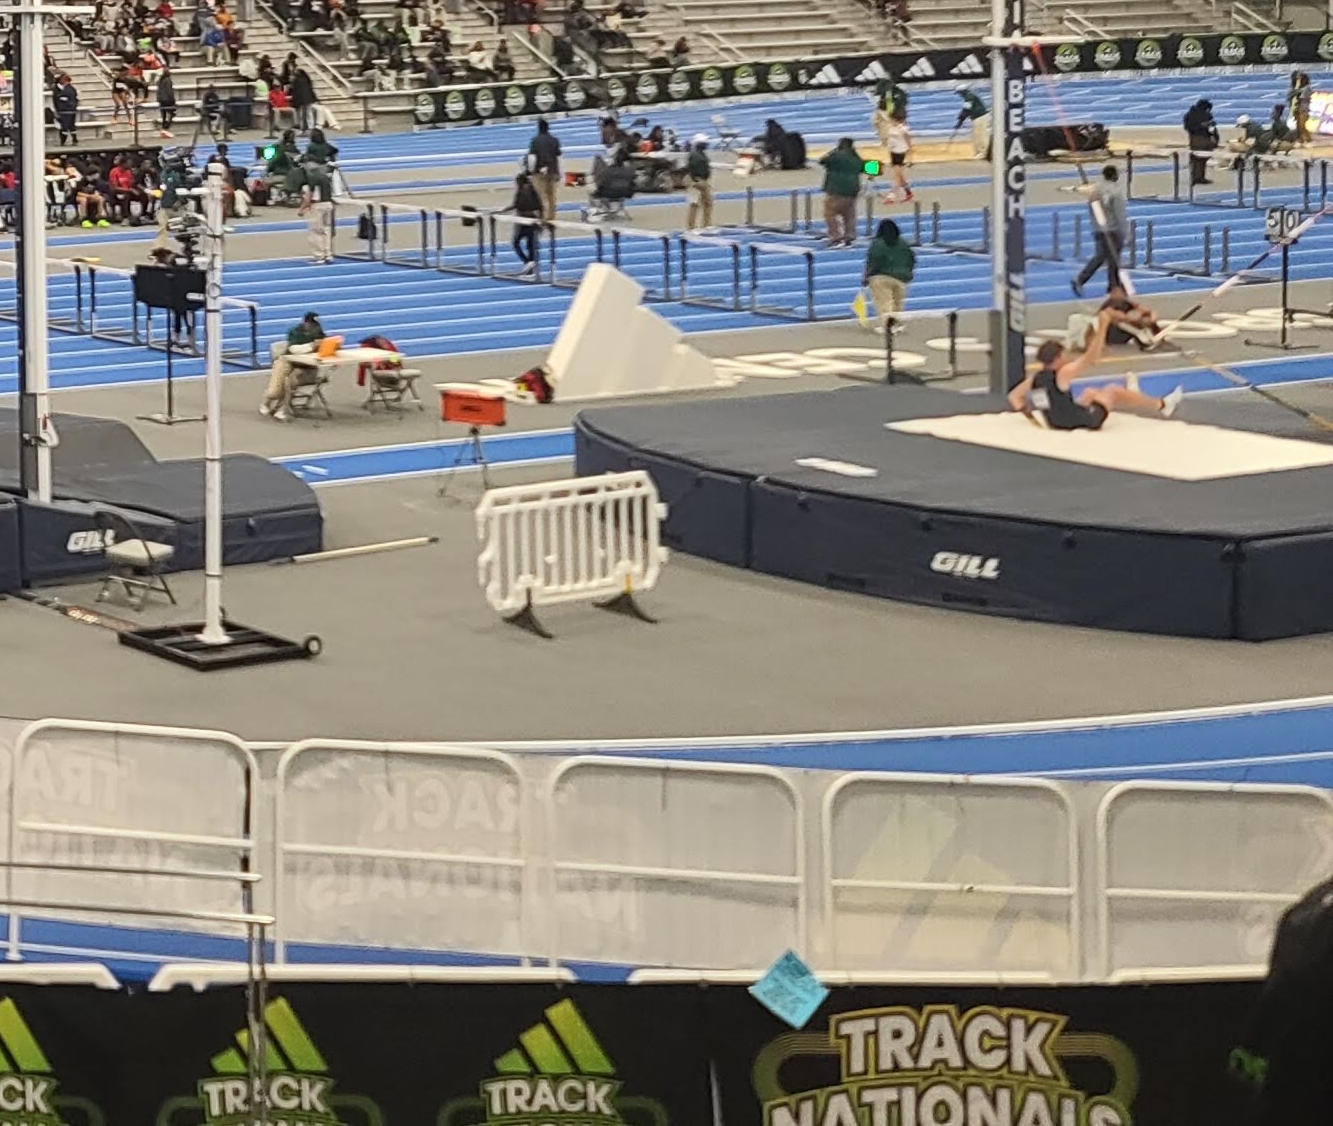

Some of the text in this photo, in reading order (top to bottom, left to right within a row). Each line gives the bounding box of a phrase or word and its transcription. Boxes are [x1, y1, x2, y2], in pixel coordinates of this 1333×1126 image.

[1007, 79, 1025, 219] BEACH
[66, 528, 115, 554] GILL
[930, 551, 1001, 579] GILL
[838, 1012, 1055, 1074] TRACK
[203, 1075, 325, 1116] TRACK
[484, 1078, 613, 1115] TRACK
